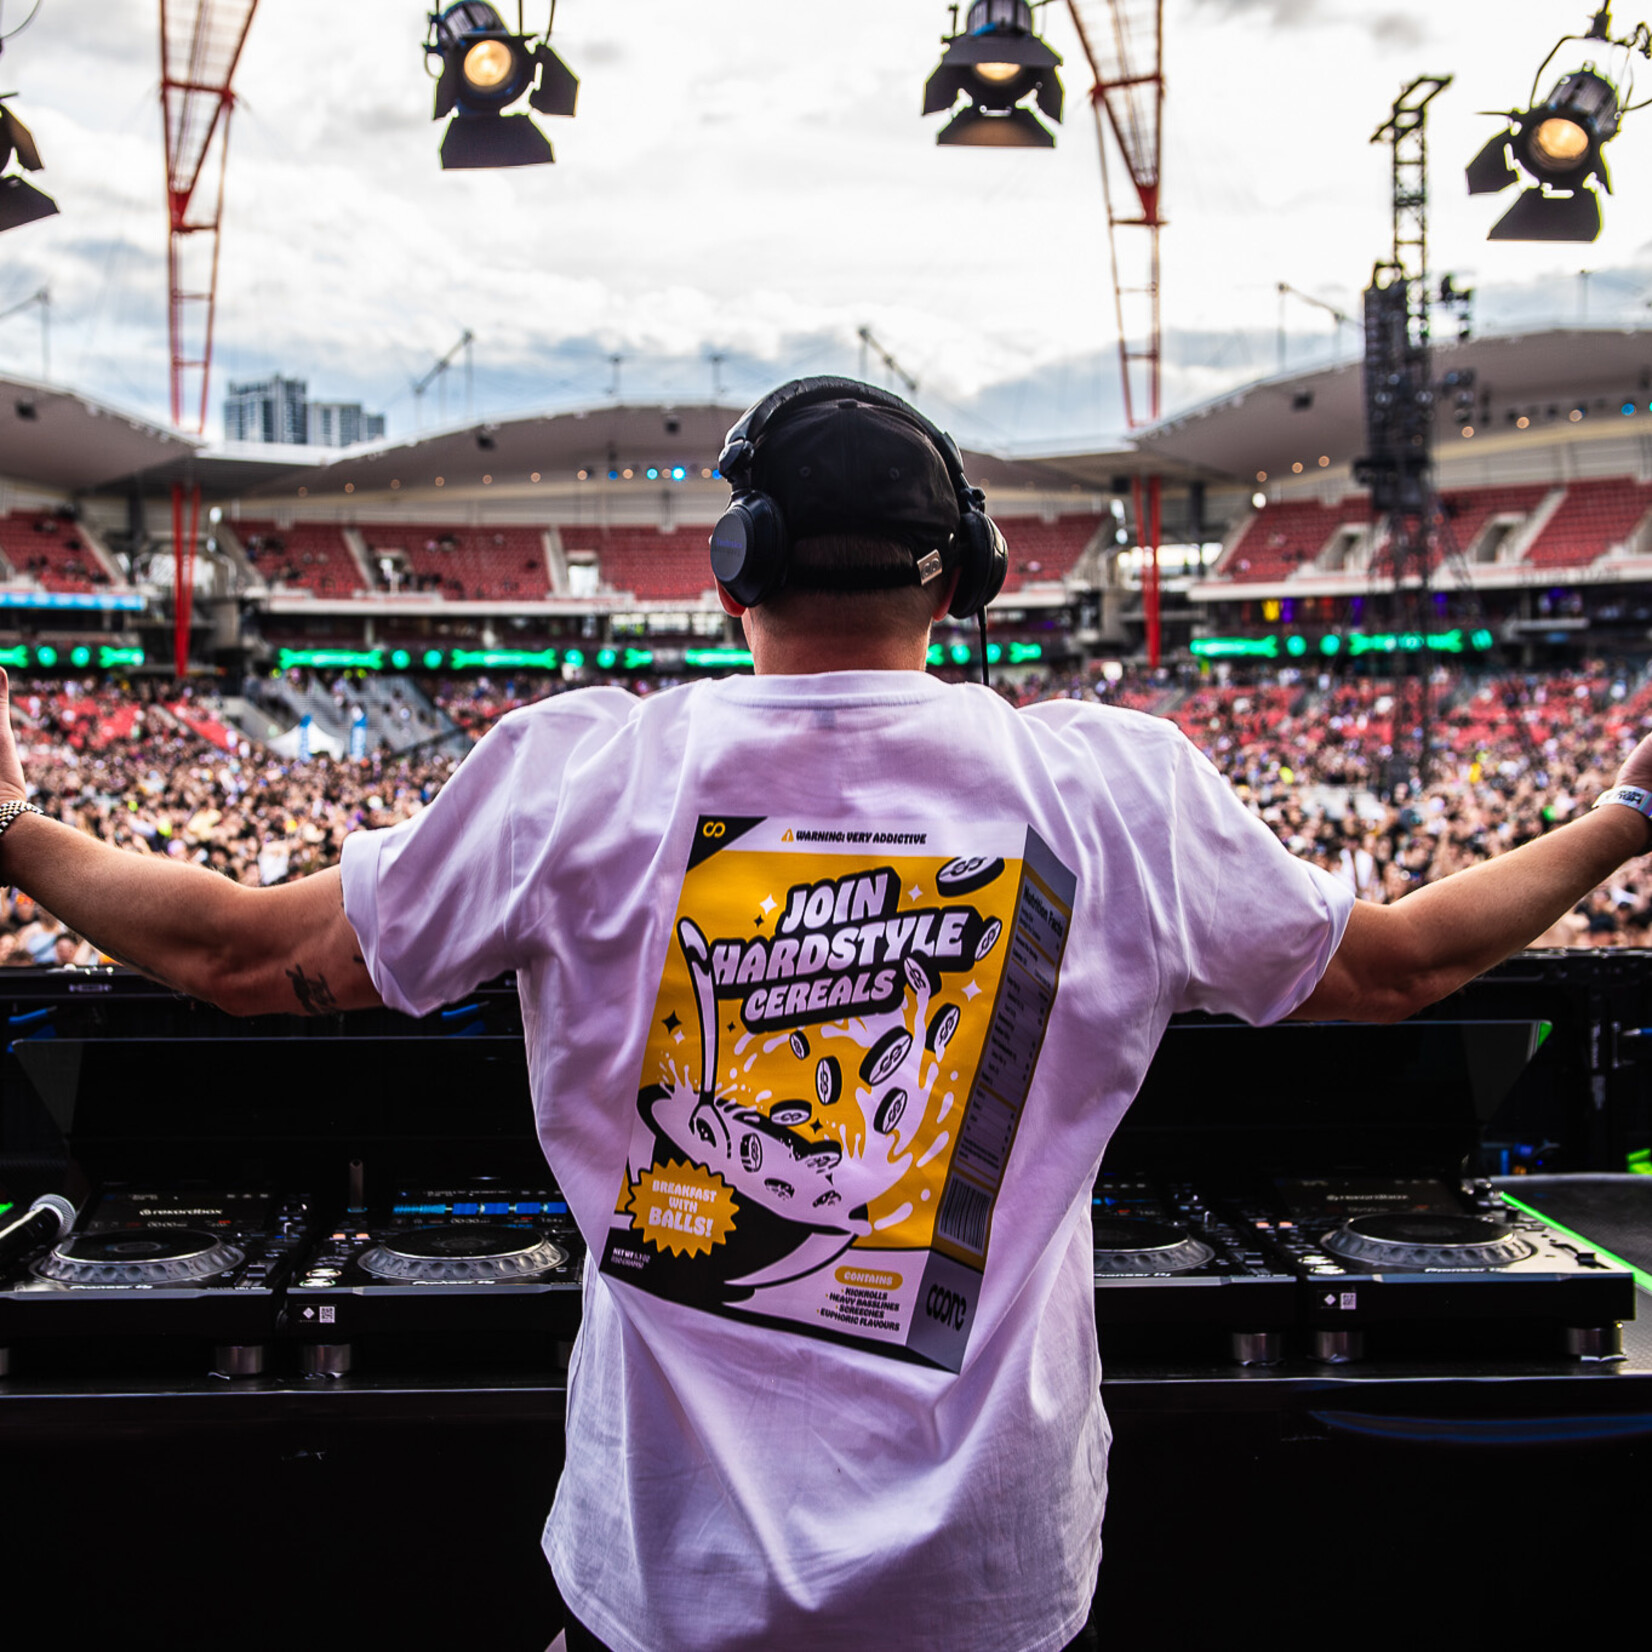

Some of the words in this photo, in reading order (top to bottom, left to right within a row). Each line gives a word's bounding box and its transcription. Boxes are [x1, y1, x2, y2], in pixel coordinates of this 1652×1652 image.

[846, 831, 873, 844] VERY
[872, 832, 927, 845] ADDICTIVE
[781, 871, 889, 934] JOIN
[1022, 884, 1048, 922] Nutrition
[712, 911, 971, 986] HARDSTYLE
[744, 968, 897, 1022] CEREALS
[652, 1179, 717, 1203] BREAKFAST
[668, 1195, 698, 1214] WITH
[648, 1205, 715, 1238] BALLS!
[843, 1270, 894, 1287] CONTAINS
[829, 1292, 856, 1305] HEAVY
[856, 1299, 900, 1312] BASSLINES
[845, 1287, 888, 1300] KICKROLLS
[820, 1307, 859, 1325] EUPHORIC
[859, 1317, 900, 1332] FLAVOURS
[839, 1304, 884, 1319] SCREECHES
